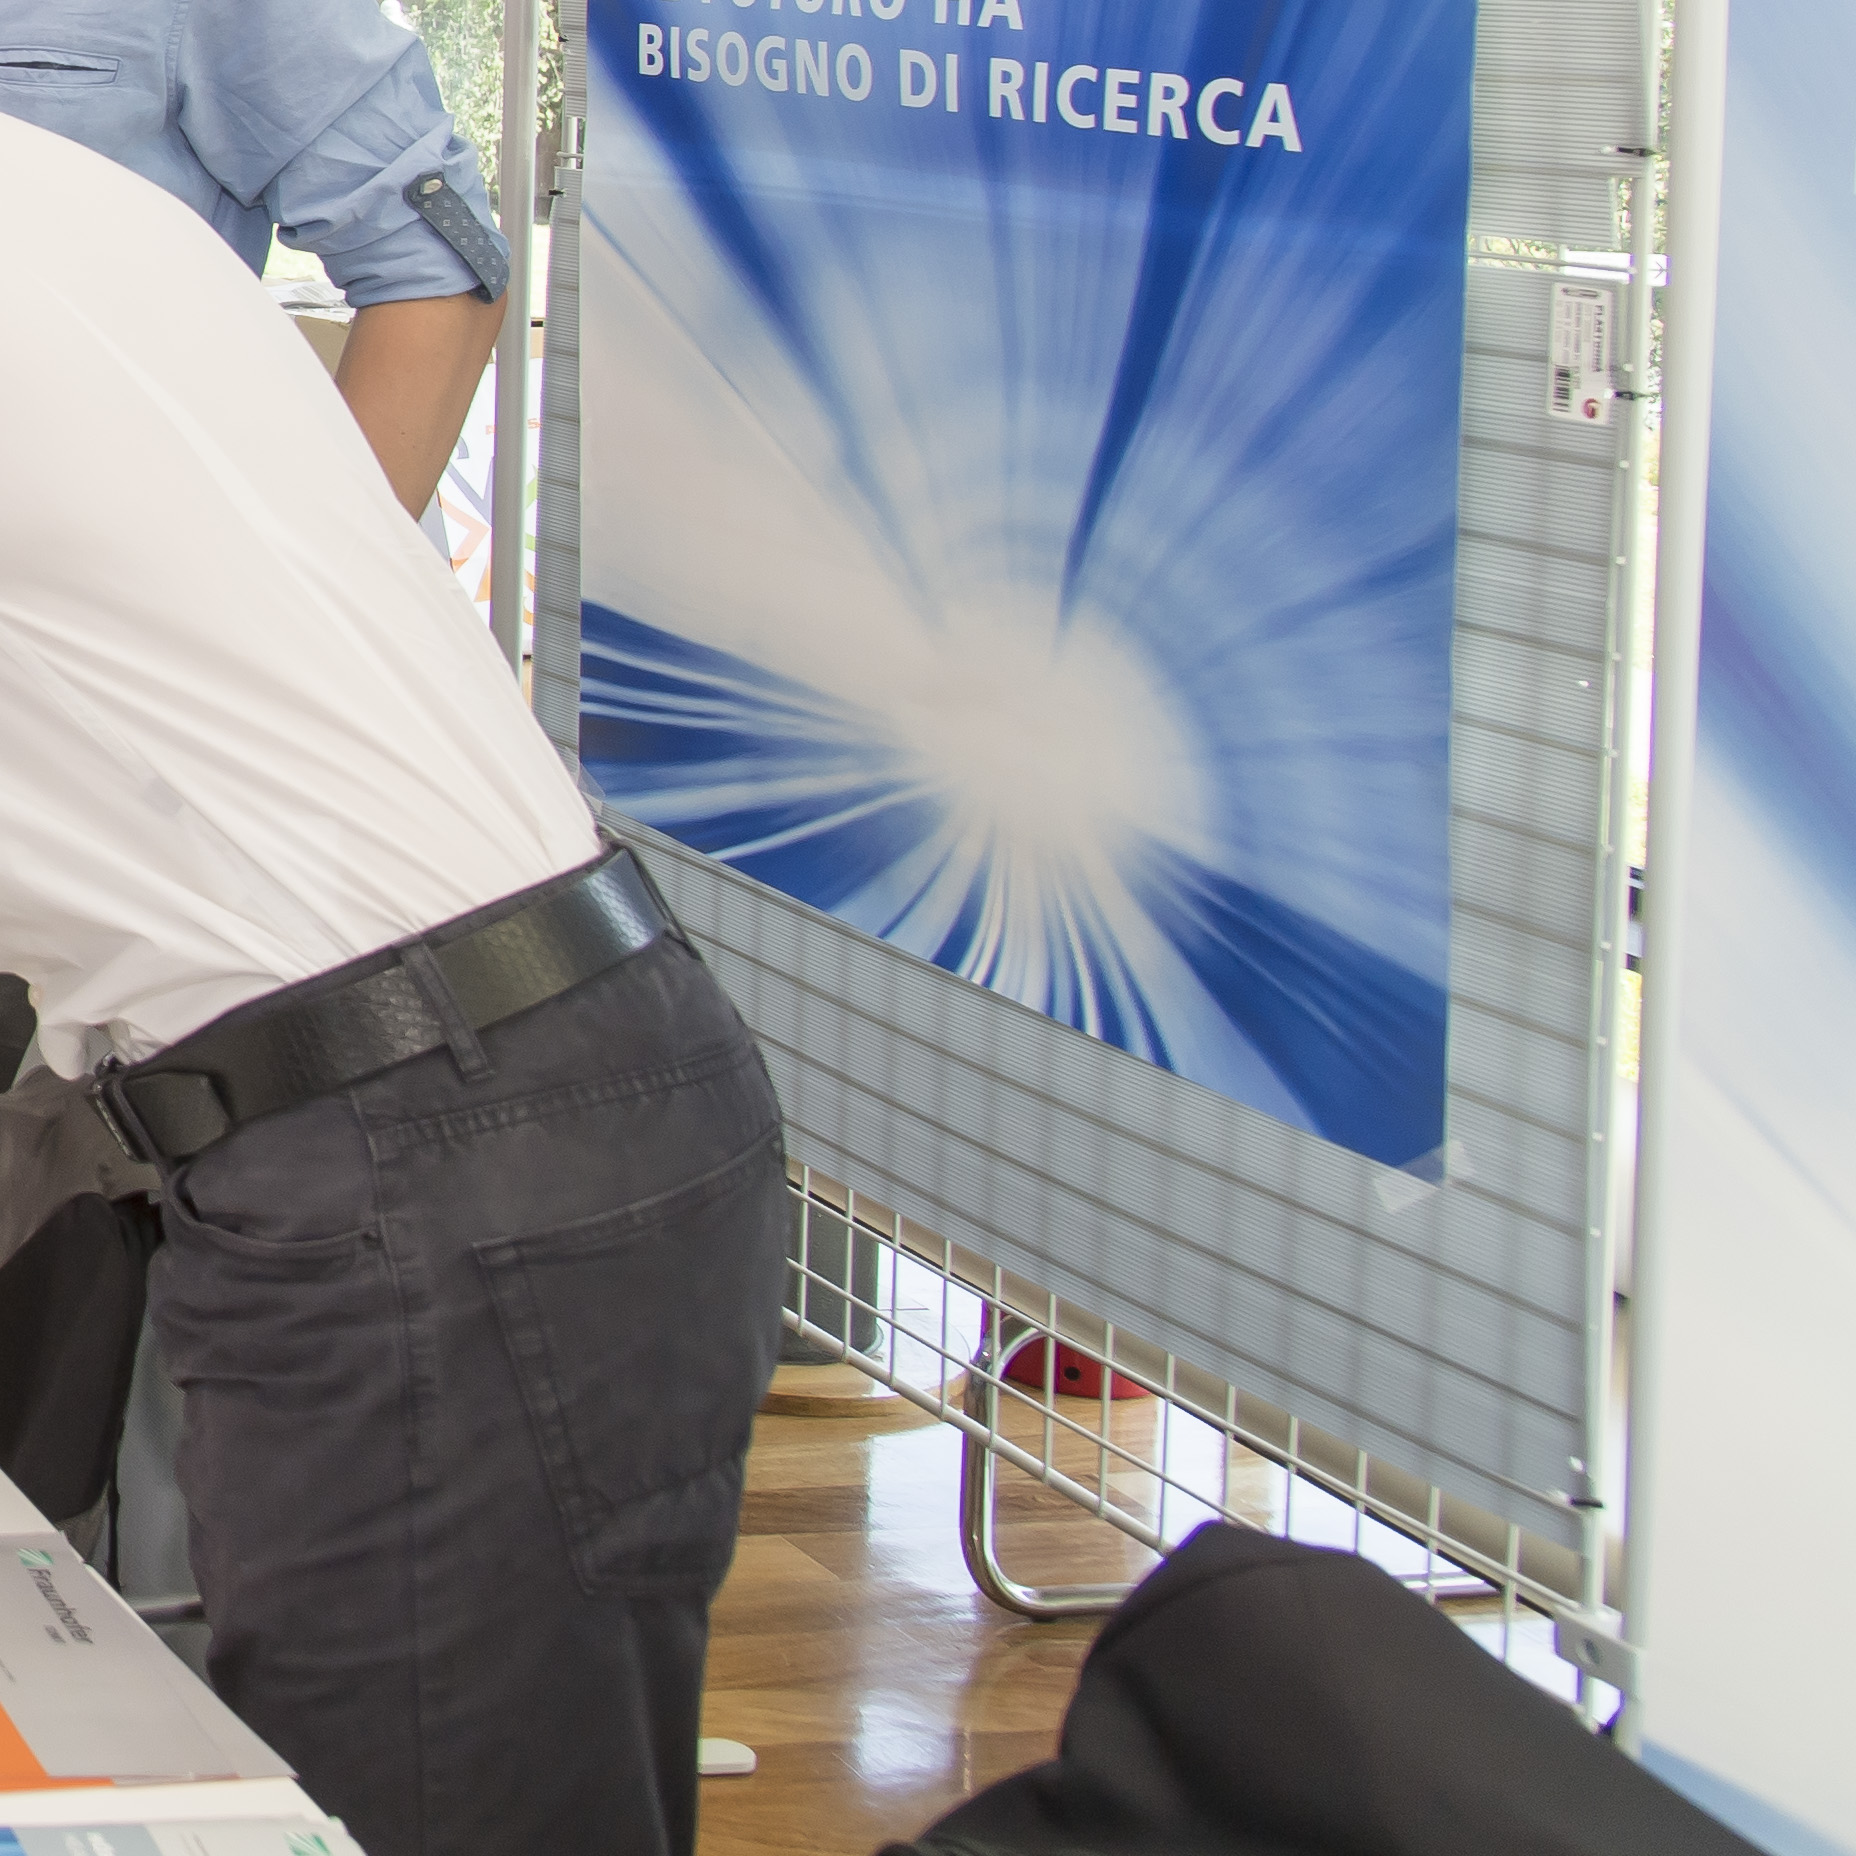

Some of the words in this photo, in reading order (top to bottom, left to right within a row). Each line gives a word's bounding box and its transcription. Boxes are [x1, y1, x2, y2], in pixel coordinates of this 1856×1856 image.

[637, 22, 873, 102] BISOGNO
[899, 51, 960, 114] DI
[987, 57, 1304, 154] RICERCA
